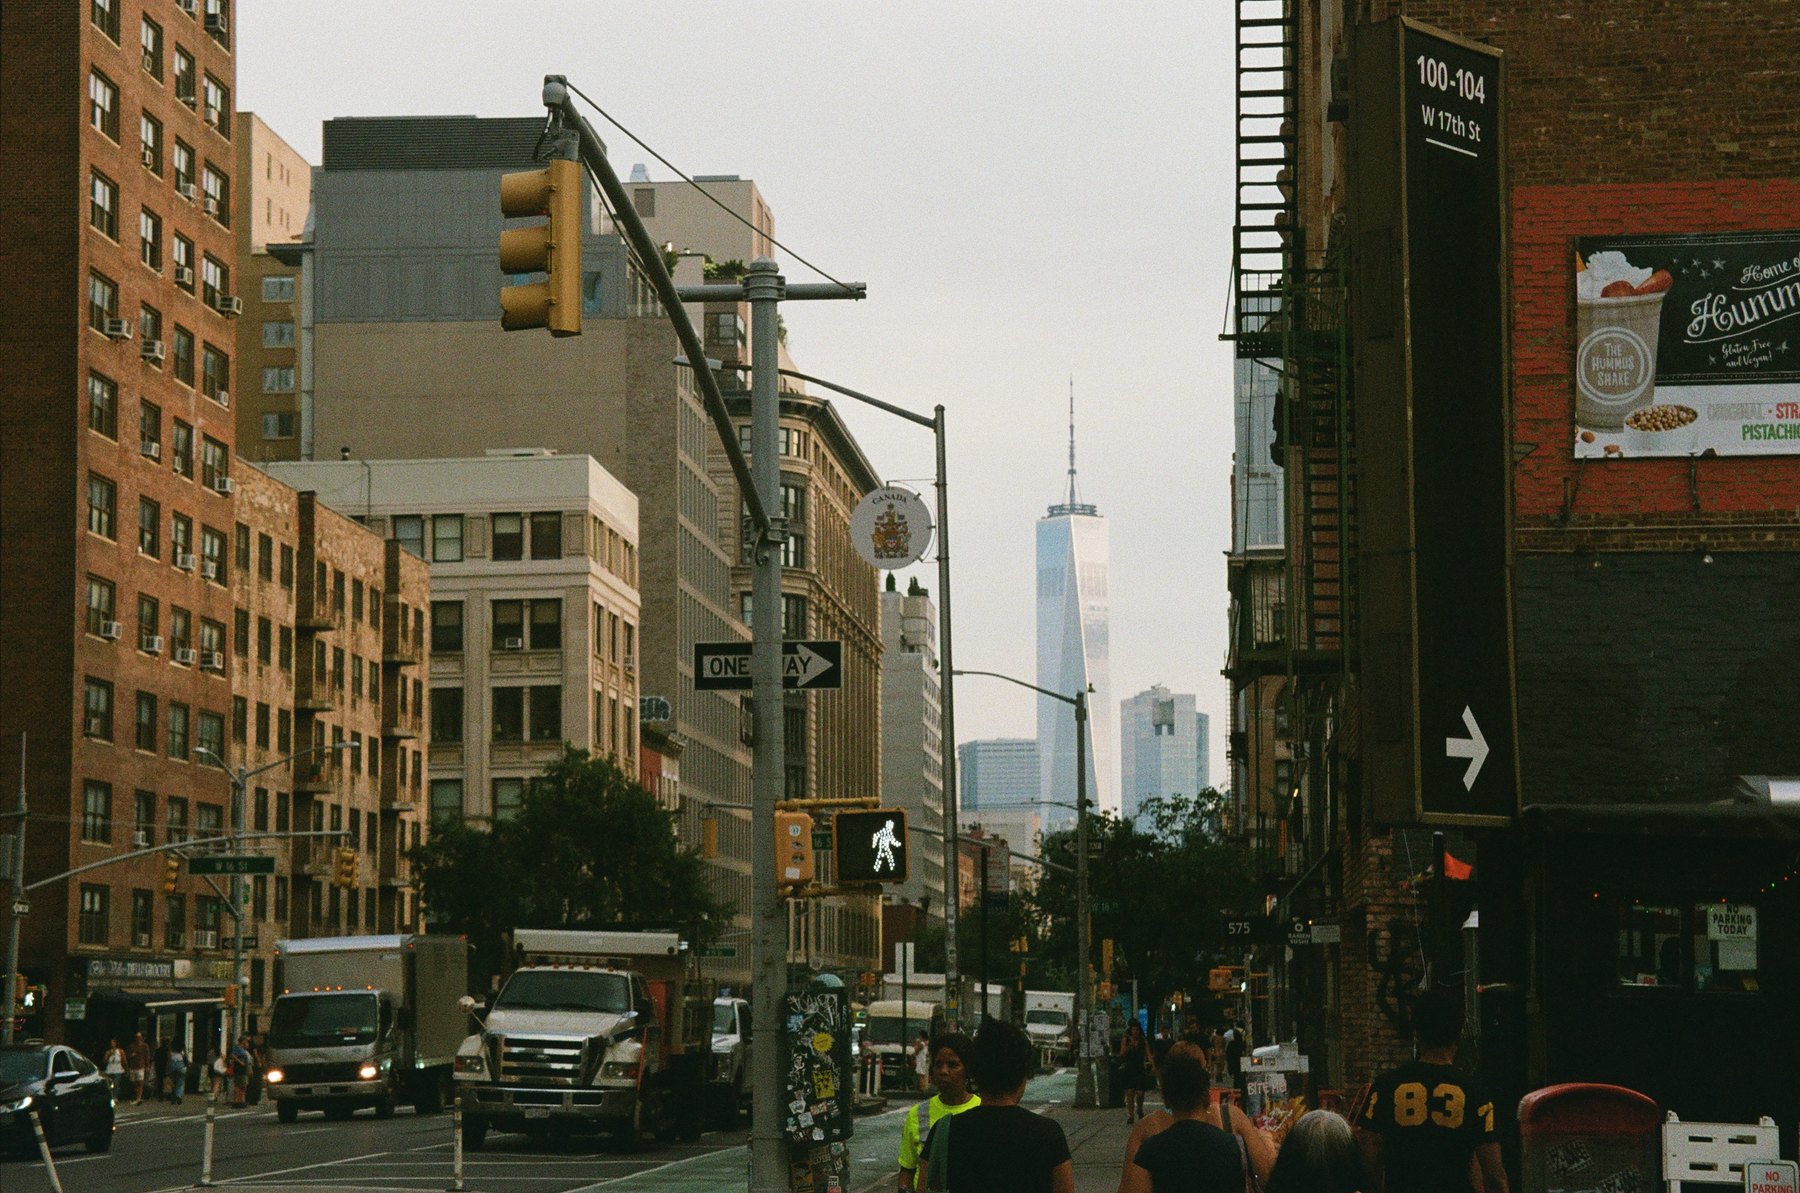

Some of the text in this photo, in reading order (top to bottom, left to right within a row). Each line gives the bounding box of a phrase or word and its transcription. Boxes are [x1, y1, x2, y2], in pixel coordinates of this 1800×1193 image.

[1417, 55, 1485, 104] 100-104
[1422, 104, 1481, 142] W 17th St
[1740, 261, 1792, 284] Home
[1605, 343, 1622, 356] THE
[1592, 356, 1634, 371] HUMMUS
[1597, 371, 1630, 386] SHAKE
[1776, 402, 1800, 419] STR
[872, 493, 907, 505] CANADA
[710, 656, 812, 675] ONE AY
[1727, 904, 1739, 913] NO
[1713, 914, 1752, 924] PARKING
[1228, 922, 1251, 935] 575
[1718, 925, 1747, 935] TODAY
[1394, 1082, 1466, 1129] 83
[1765, 1171, 1780, 1181] NO
[1752, 1183, 1793, 1193] PARKING
